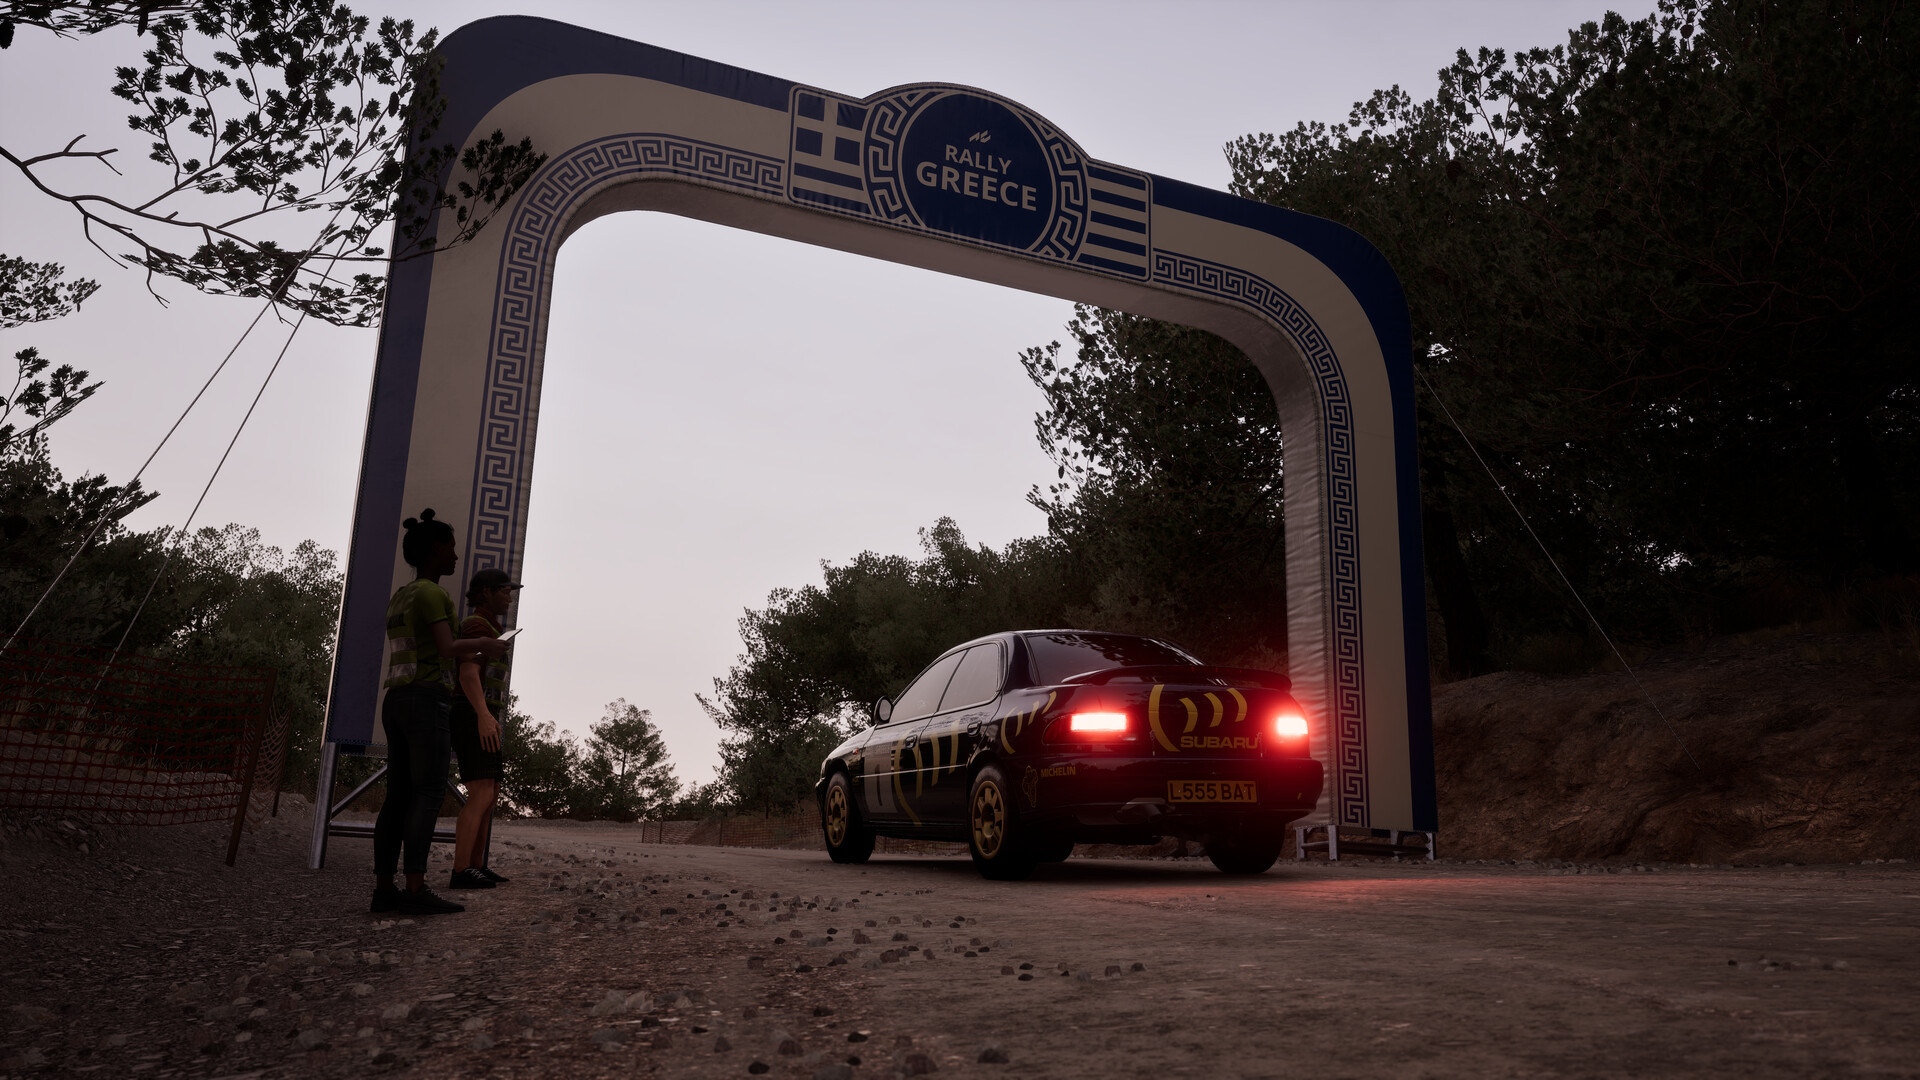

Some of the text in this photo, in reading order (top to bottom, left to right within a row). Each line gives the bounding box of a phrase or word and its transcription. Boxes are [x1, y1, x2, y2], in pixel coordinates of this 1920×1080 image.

[945, 144, 1012, 175] RALLY
[916, 161, 1037, 212] GREECE
[1180, 735, 1259, 749] SUBARU
[1040, 765, 1077, 777] MICHELIN
[1170, 783, 1255, 800] L555 BAT
